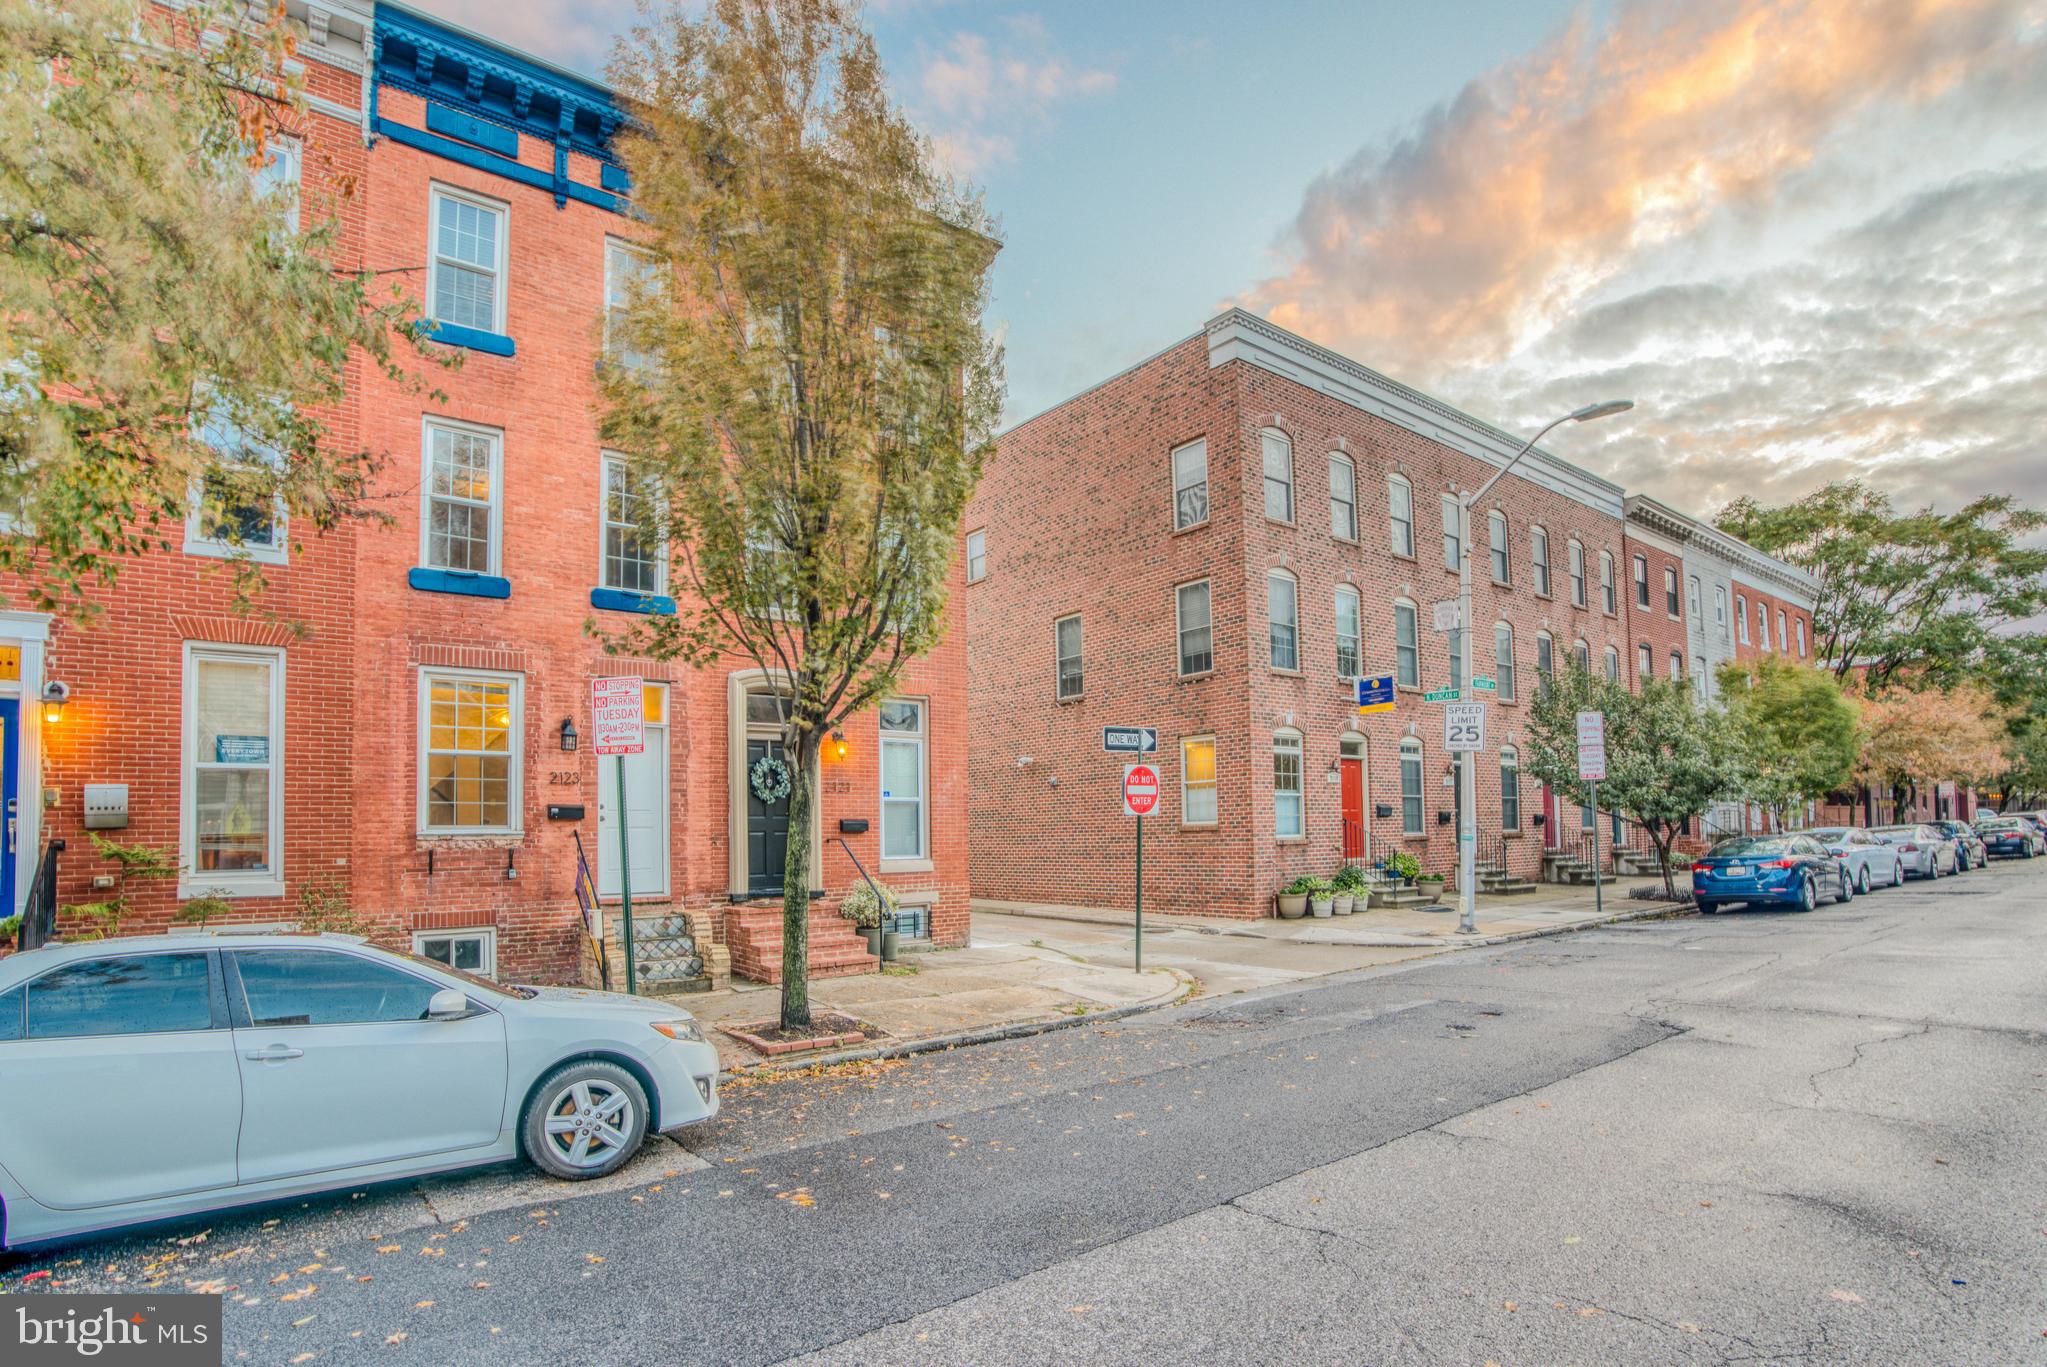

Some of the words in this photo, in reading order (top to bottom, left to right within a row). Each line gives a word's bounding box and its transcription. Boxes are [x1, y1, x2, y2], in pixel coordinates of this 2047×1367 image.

[596, 681, 607, 691] NO
[608, 680, 640, 690] STOPPING
[596, 697, 607, 707] NO
[609, 696, 640, 706] PARKING
[597, 708, 640, 720] TUESDAY
[1448, 706, 1482, 714] SPEED
[1451, 716, 1477, 724] LIMIT
[1449, 725, 1480, 742] 25
[1109, 734, 1125, 744] ONE
[627, 745, 643, 753] ZONE
[549, 771, 580, 785] 2123
[1130, 775, 1139, 783] DO
[1141, 775, 1154, 783] NOT
[1132, 796, 1152, 805] ENTER
